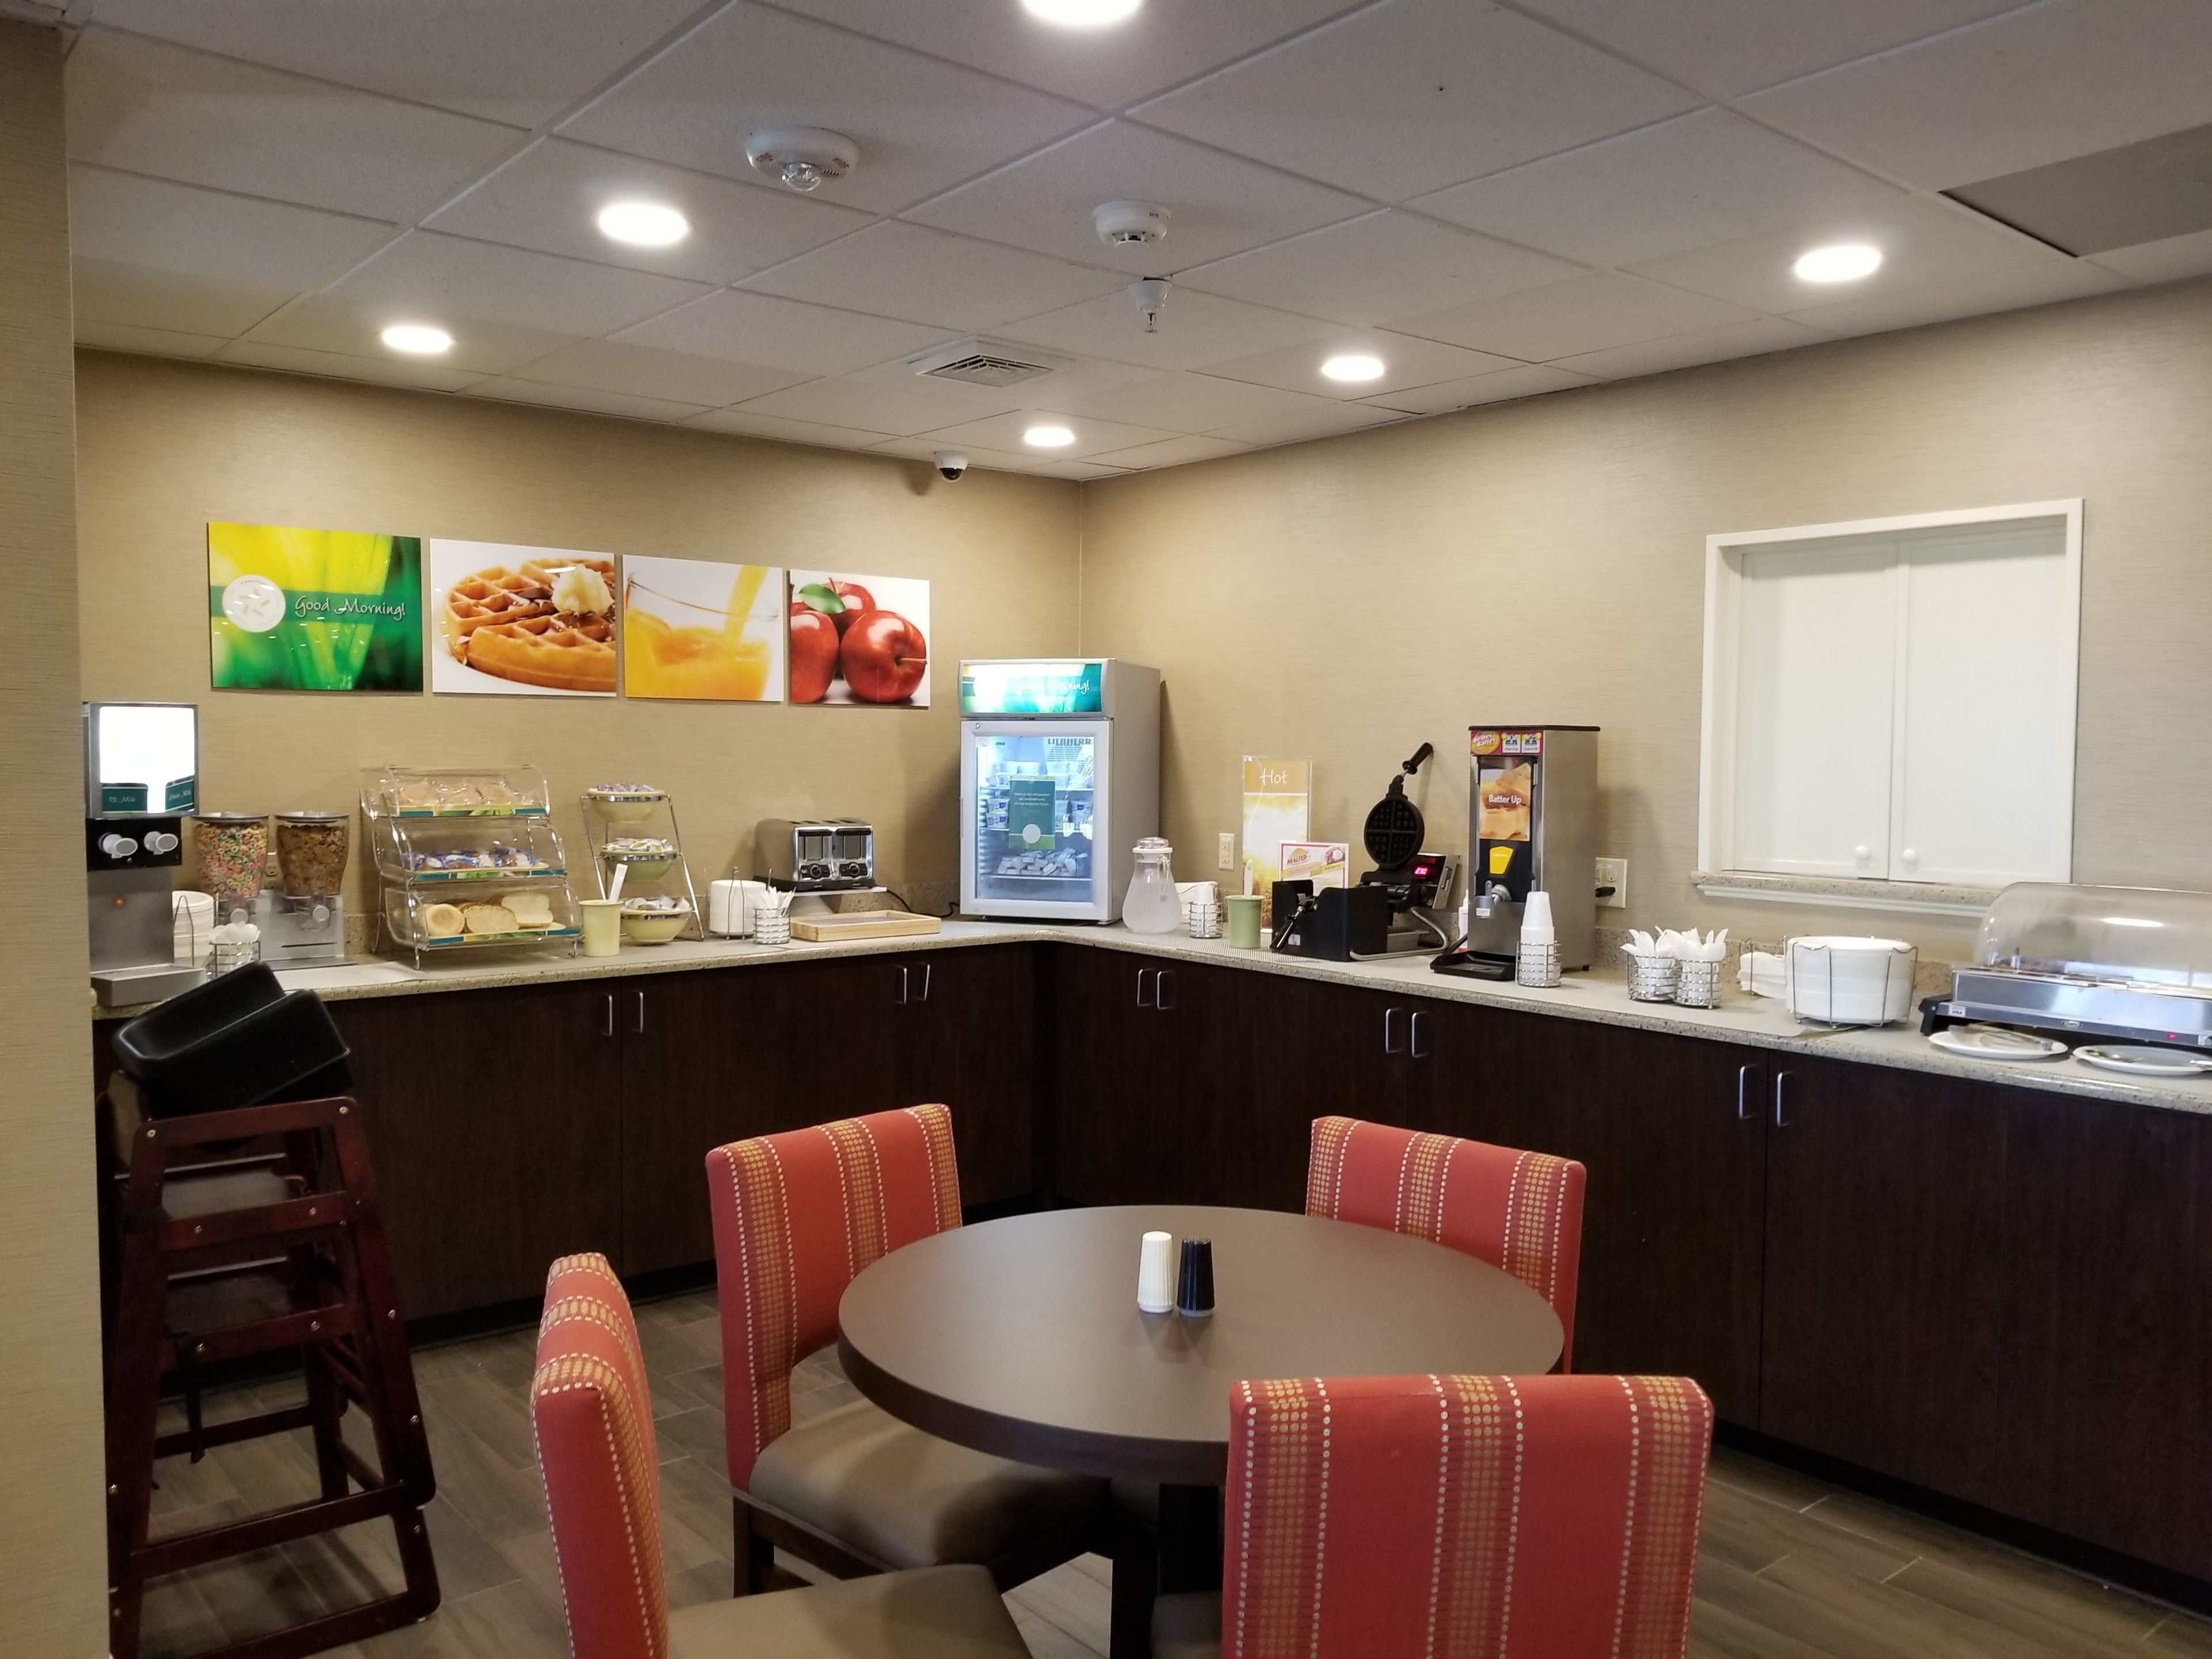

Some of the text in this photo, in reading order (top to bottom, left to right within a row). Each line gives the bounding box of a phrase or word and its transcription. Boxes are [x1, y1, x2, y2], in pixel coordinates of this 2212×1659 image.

[294, 595, 406, 621] Good Morning!
[1047, 738, 1093, 746] LIEBHERR
[1259, 768, 1287, 786] Hot
[1488, 795, 1522, 805] Batter Up
[1286, 854, 1308, 865] MALTED
